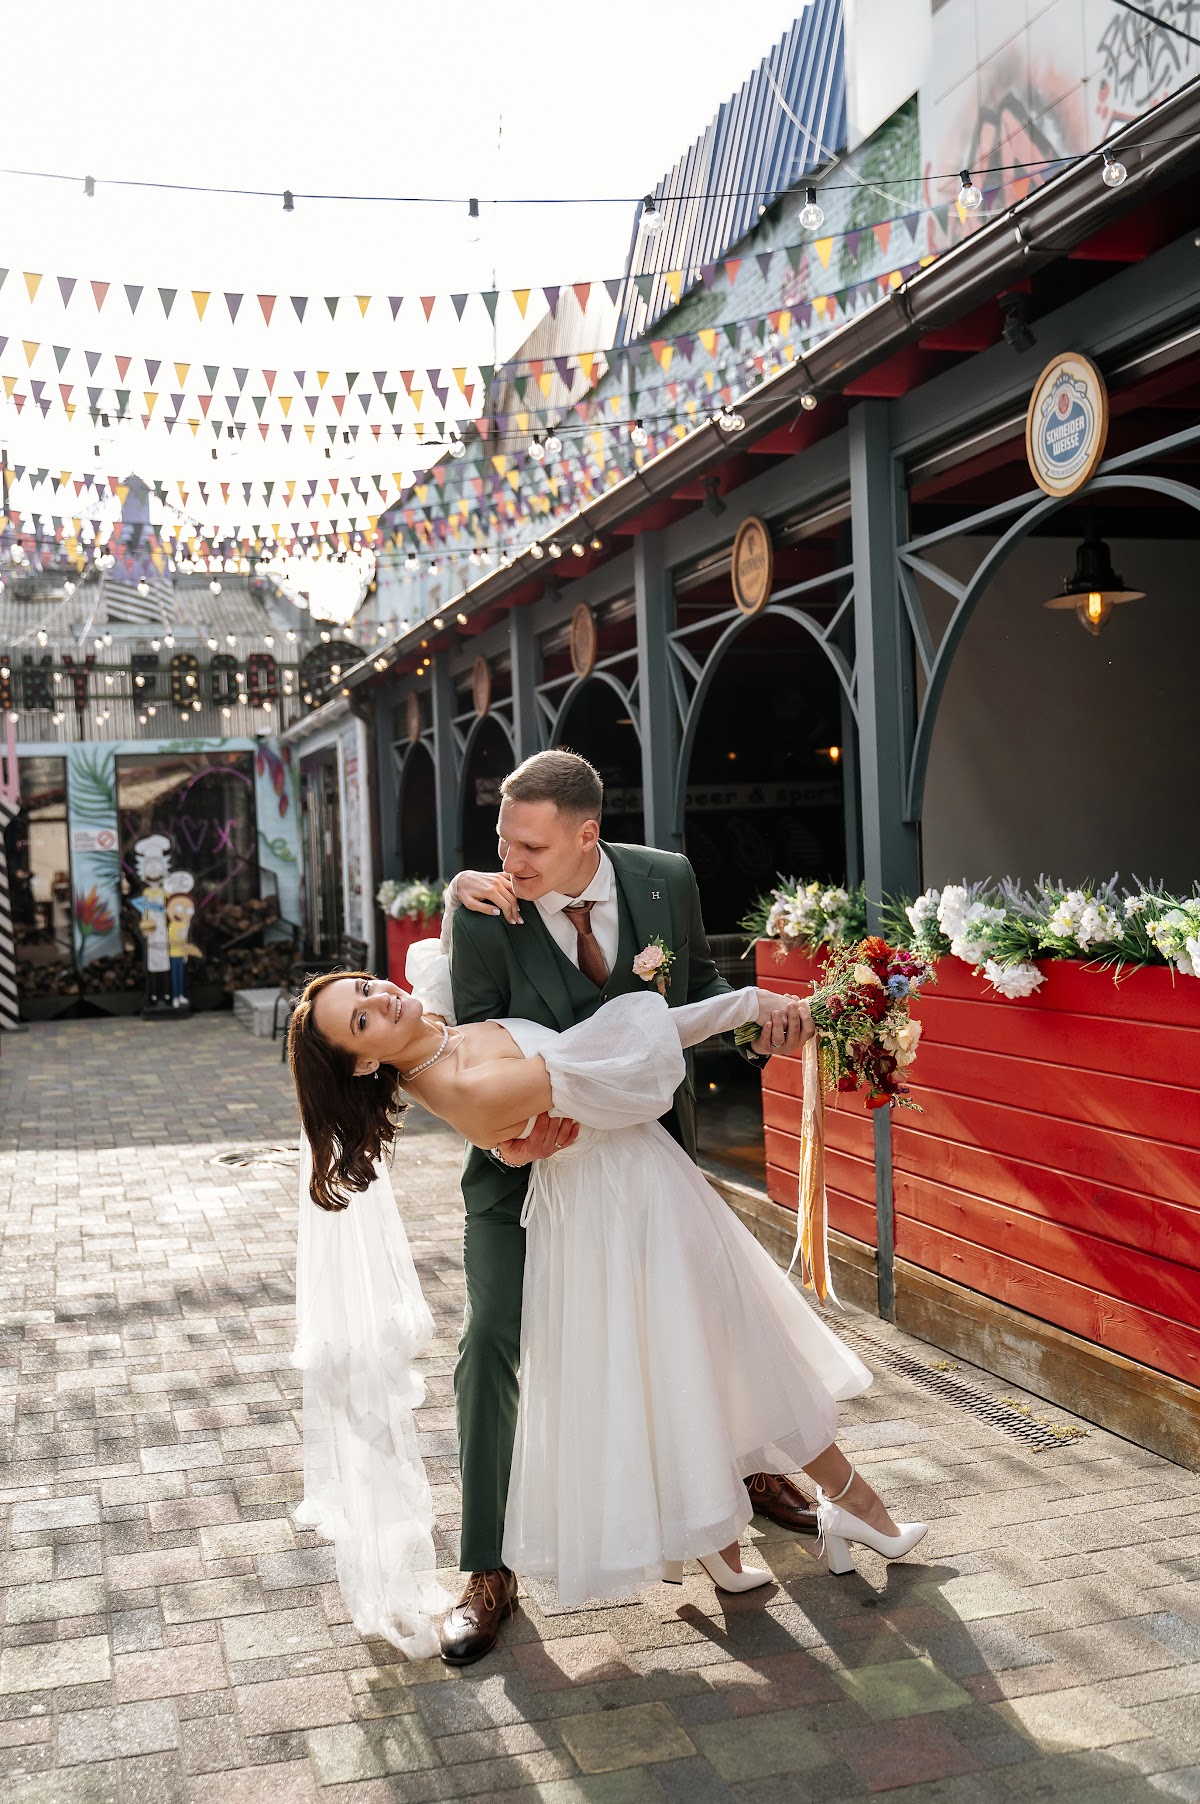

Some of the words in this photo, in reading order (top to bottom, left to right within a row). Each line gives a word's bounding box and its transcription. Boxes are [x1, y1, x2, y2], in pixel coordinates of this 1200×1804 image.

[1046, 415, 1085, 445] SCHNEIDER
[1052, 433, 1080, 457] WEISSE
[131, 653, 277, 708] FOOD
